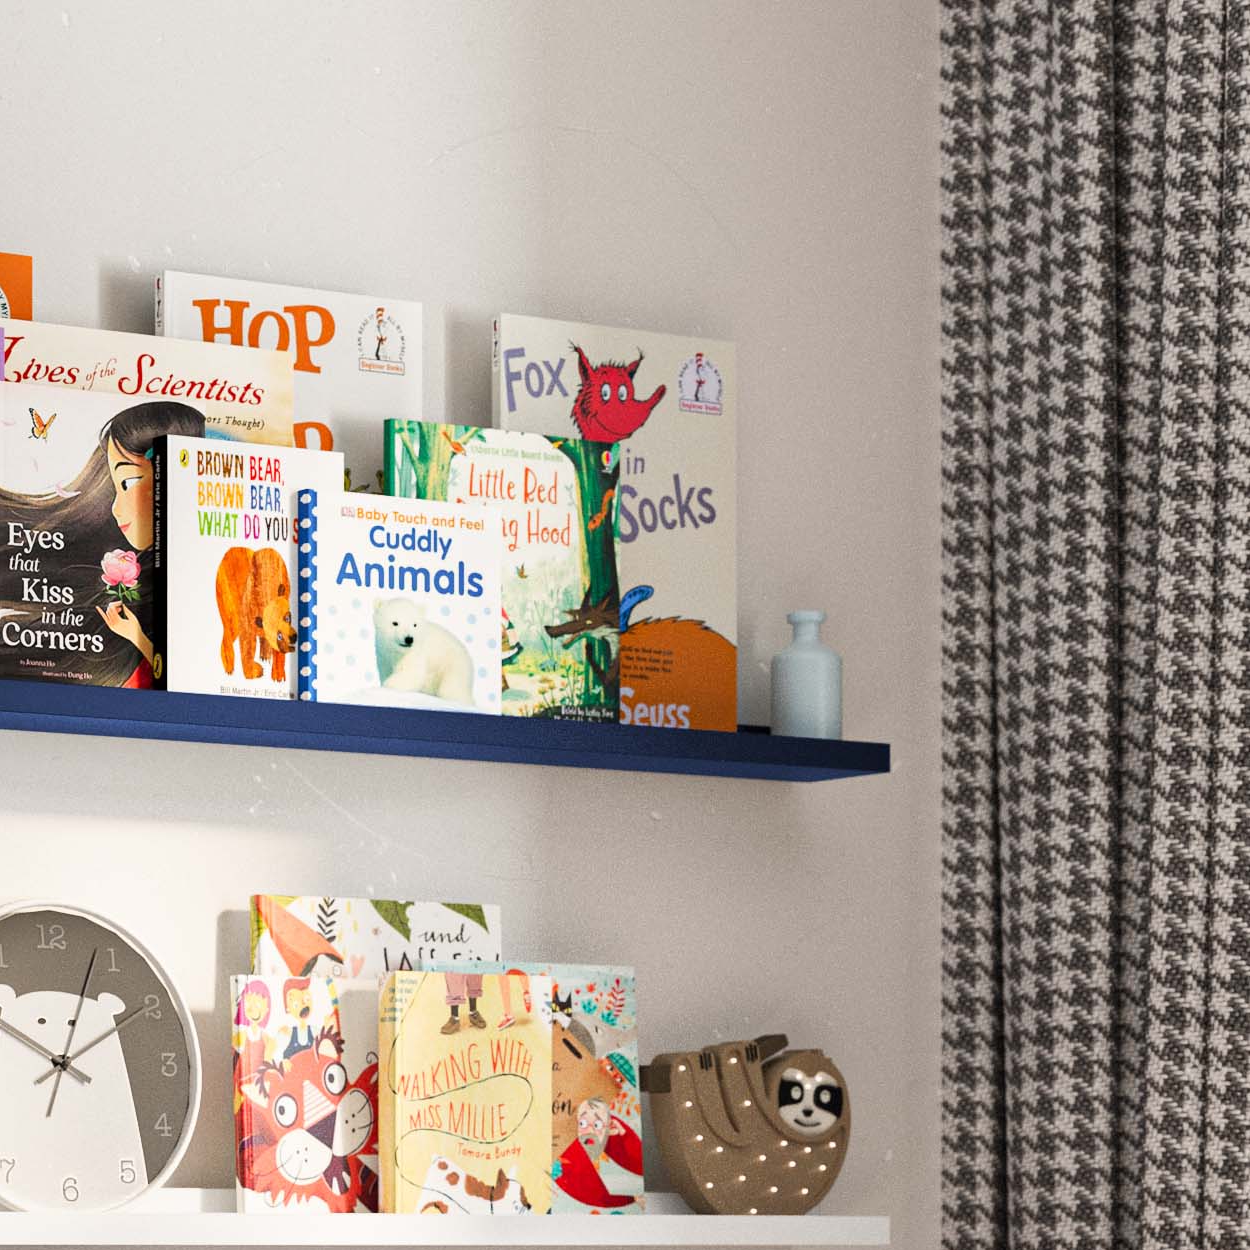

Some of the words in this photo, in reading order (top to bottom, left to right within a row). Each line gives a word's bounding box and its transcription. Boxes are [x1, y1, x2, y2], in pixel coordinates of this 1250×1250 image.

[192, 298, 336, 374] HOP
[85, 364, 99, 390] of
[100, 358, 116, 379] the
[118, 354, 264, 406] Scientists
[503, 347, 569, 412] Fox
[225, 415, 265, 431] Thought)
[197, 450, 244, 479] BROWN
[250, 455, 285, 486] BEAR,
[626, 448, 645, 476] in
[197, 481, 244, 510] BROWN
[250, 485, 284, 514] BEAR,
[469, 463, 516, 500] Little
[524, 466, 558, 505] Red
[357, 507, 389, 523] Baby
[393, 511, 427, 526] Touch
[432, 516, 455, 528] and
[460, 518, 484, 530] Feel
[619, 474, 717, 544] Socks
[7, 522, 65, 554] Eyes
[197, 511, 238, 539] WHAT
[244, 514, 260, 539] DO
[265, 516, 288, 541] YOU
[527, 510, 570, 547] Hood
[369, 525, 453, 560] Cuddly
[8, 553, 40, 573] that
[336, 552, 484, 597] Animals
[21, 577, 74, 605] Kiss
[41, 607, 57, 624] in
[60, 610, 84, 627] the
[2, 622, 104, 653] Corners
[619, 687, 692, 729] Seuss
[35, 924, 67, 950] 12
[418, 923, 471, 944] und
[107, 948, 121, 973] 1
[143, 994, 162, 1020] 2
[161, 1052, 178, 1077] 3
[398, 1043, 481, 1100] WALKING
[490, 1037, 534, 1079] WITH
[154, 1112, 172, 1137] 4
[409, 1104, 443, 1129] MISS
[448, 1101, 508, 1140] MILLIE
[457, 1142, 491, 1161] Tamara
[494, 1144, 522, 1160] Bundy
[0, 1158, 16, 1184] 7
[119, 1160, 136, 1184] 5
[62, 1177, 79, 1202] 6
